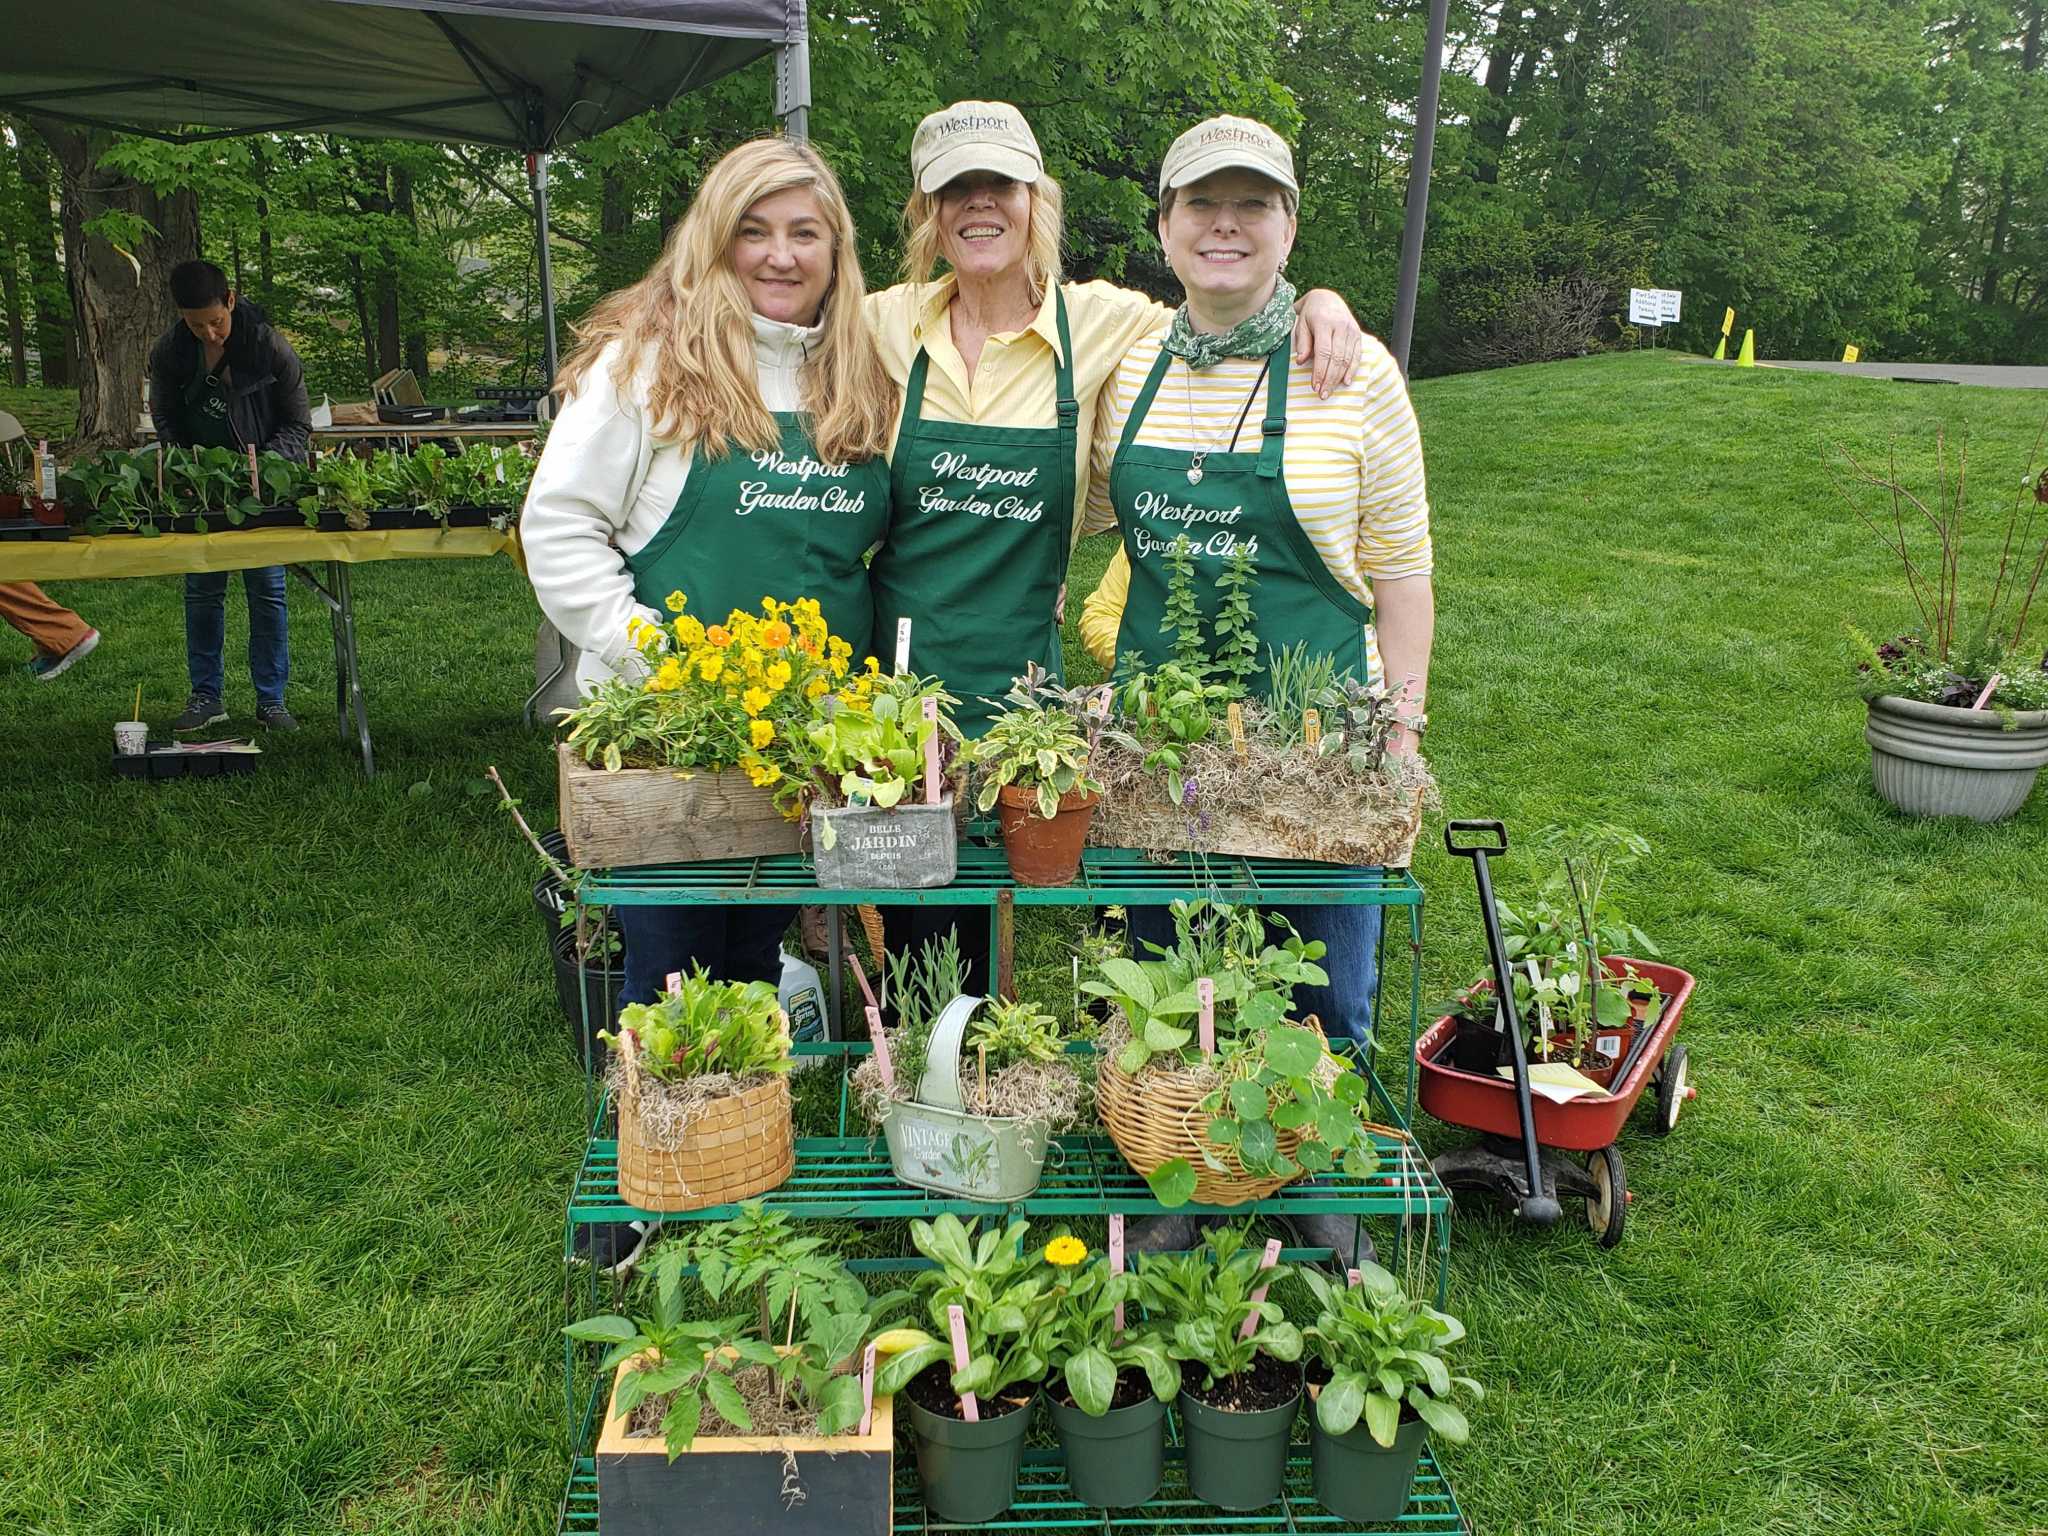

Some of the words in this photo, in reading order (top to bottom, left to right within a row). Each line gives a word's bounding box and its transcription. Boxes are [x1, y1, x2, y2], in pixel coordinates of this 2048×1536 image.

[939, 115, 1009, 136] Westport
[1200, 127, 1273, 148] Westport
[751, 448, 850, 482] Westport
[931, 451, 1039, 490] Westport
[735, 481, 820, 515] Garden
[820, 486, 865, 513] Club
[918, 486, 993, 517] Garden
[993, 496, 1045, 522] Club
[1134, 491, 1243, 529] Westport
[1134, 527, 1204, 559] Garn
[851, 835, 917, 850] JARDIN
[870, 825, 902, 834] BELLE
